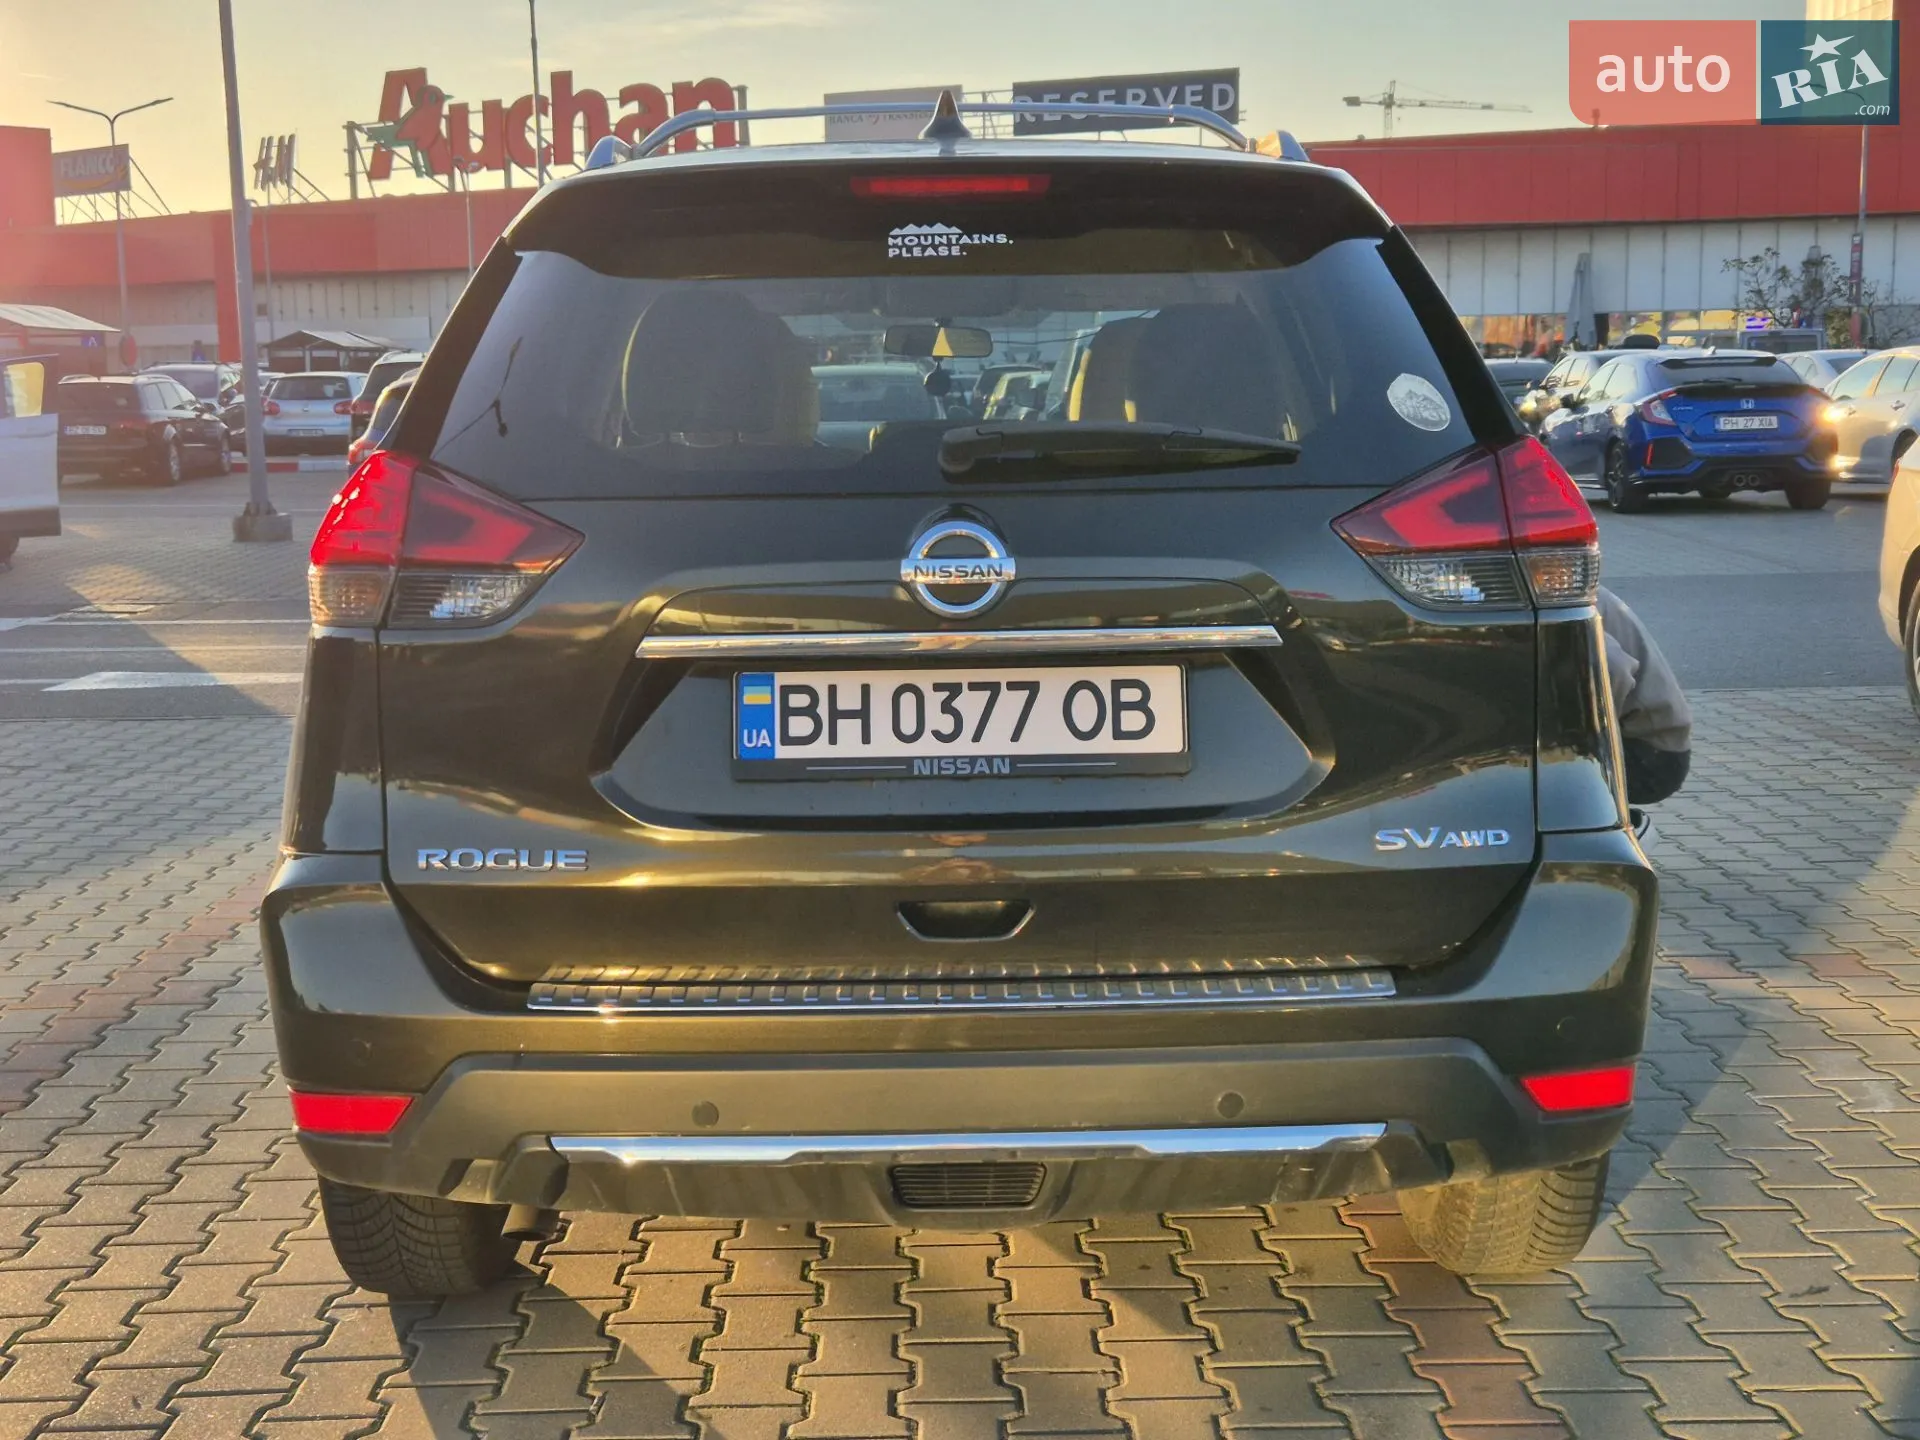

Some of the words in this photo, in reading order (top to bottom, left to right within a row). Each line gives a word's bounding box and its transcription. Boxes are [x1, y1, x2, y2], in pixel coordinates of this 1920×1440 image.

[1013, 82, 1236, 123] RESERVED
[368, 67, 737, 181] Auchan
[887, 233, 1014, 246] MOUNTAINS.
[888, 246, 968, 258] PLEASE.
[1723, 418, 1738, 428] PH
[1743, 418, 1755, 428] 27
[913, 563, 1003, 579] NISSAN
[743, 728, 772, 748] UA
[779, 683, 871, 746] BH
[891, 681, 1040, 744] 0377
[1062, 678, 1156, 742] OB
[913, 757, 1011, 776] NISSAN
[1375, 826, 1441, 851] SV
[1440, 829, 1510, 849] AWD
[416, 847, 589, 872] ROGUE
